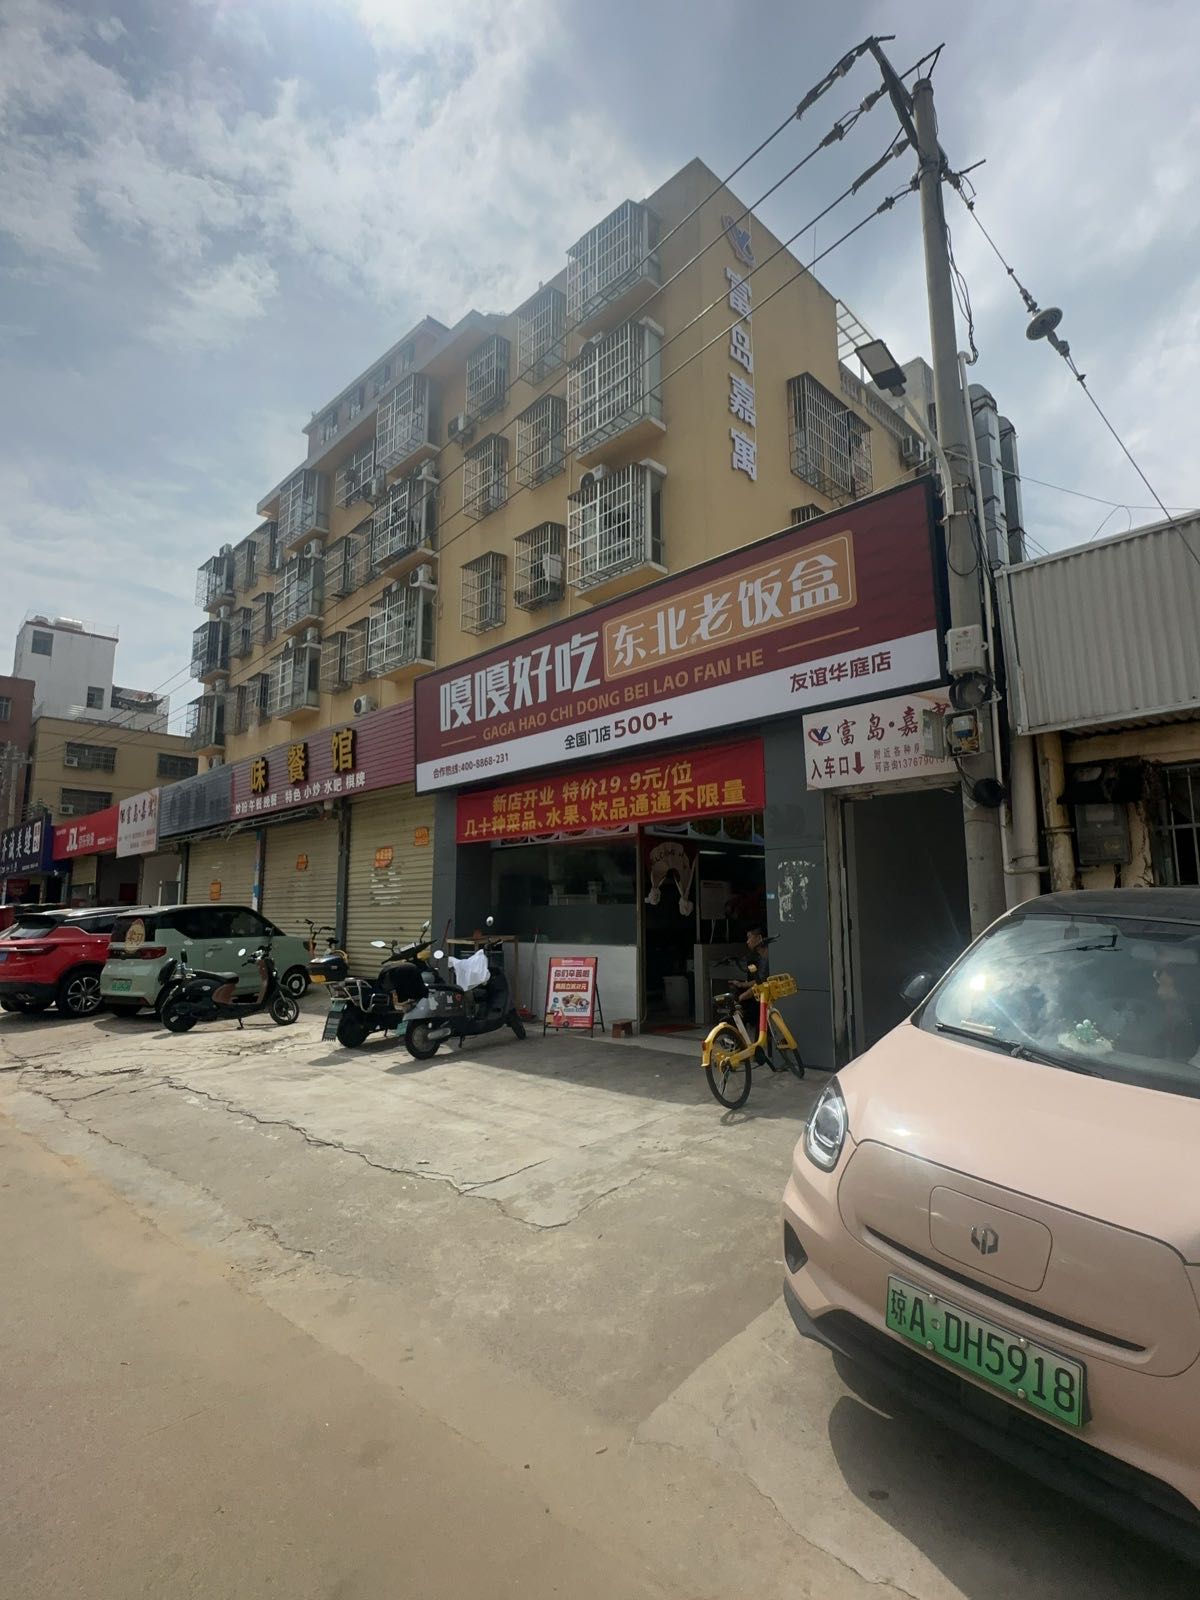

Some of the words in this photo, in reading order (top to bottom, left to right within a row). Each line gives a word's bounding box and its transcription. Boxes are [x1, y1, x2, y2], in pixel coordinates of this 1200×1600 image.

[440, 631, 600, 732] 嘎嘎好吃
[612, 553, 842, 669] 东北老饭盒
[482, 720, 516, 742] GAGA
[518, 711, 547, 731] HAO
[550, 704, 573, 723] CHI
[577, 690, 620, 716] DONG
[624, 682, 649, 702] BEI
[653, 671, 689, 695] LAO
[694, 658, 731, 686] FAN
[737, 649, 764, 672] HE
[790, 651, 892, 693] 友谊华庭店
[250, 728, 354, 793] 味餐馆
[492, 786, 555, 814] 新店开业
[562, 761, 693, 801] 特价19.9元/位
[811, 755, 849, 780] 入车口
[285, 786, 302, 804] 特色
[303, 781, 321, 799] 小炒
[464, 778, 746, 838] 几十种菜品、水果、饮品通通不限量
